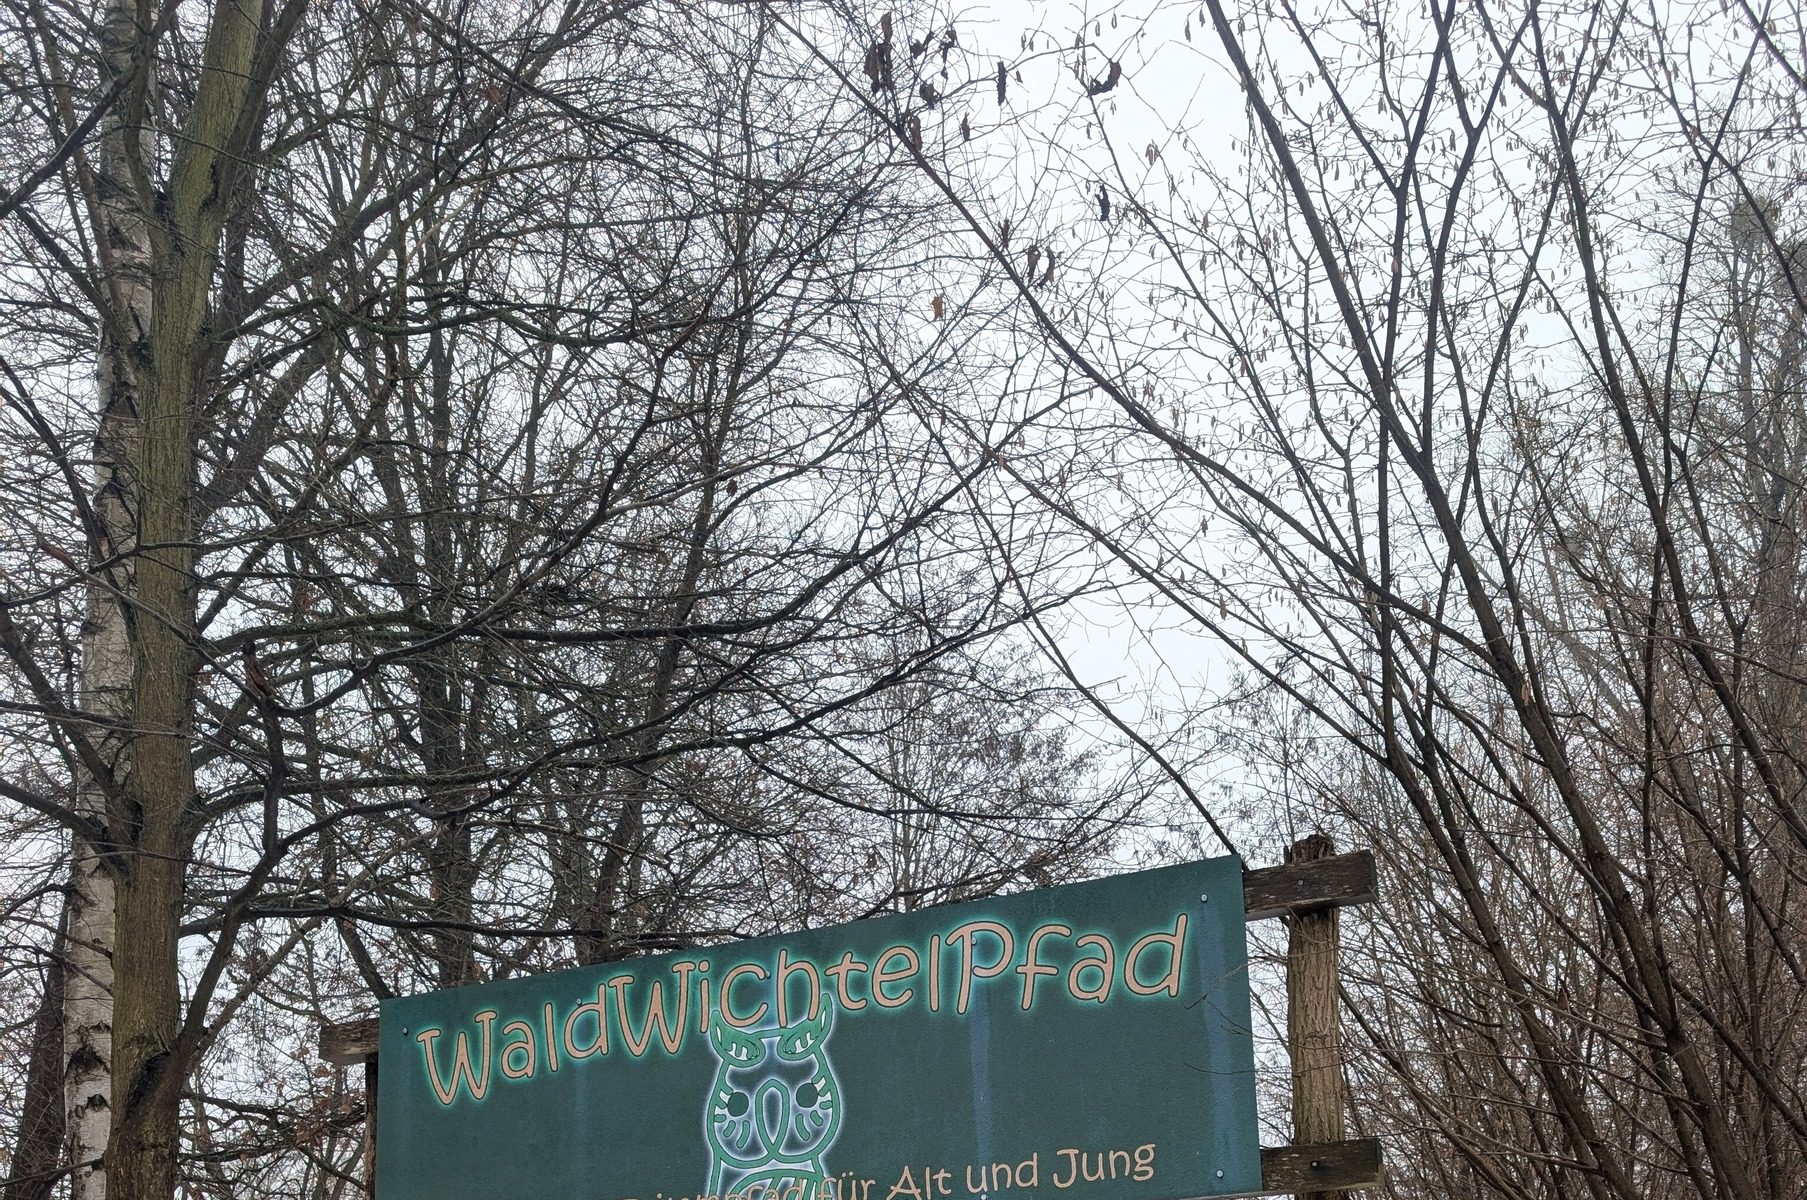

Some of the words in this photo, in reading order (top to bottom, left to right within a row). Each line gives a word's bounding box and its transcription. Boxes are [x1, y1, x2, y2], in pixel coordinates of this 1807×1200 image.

[415, 912, 1188, 1106] WaldWichtelPfad
[966, 1152, 1039, 1195] und
[1052, 1143, 1157, 1190] Jung
